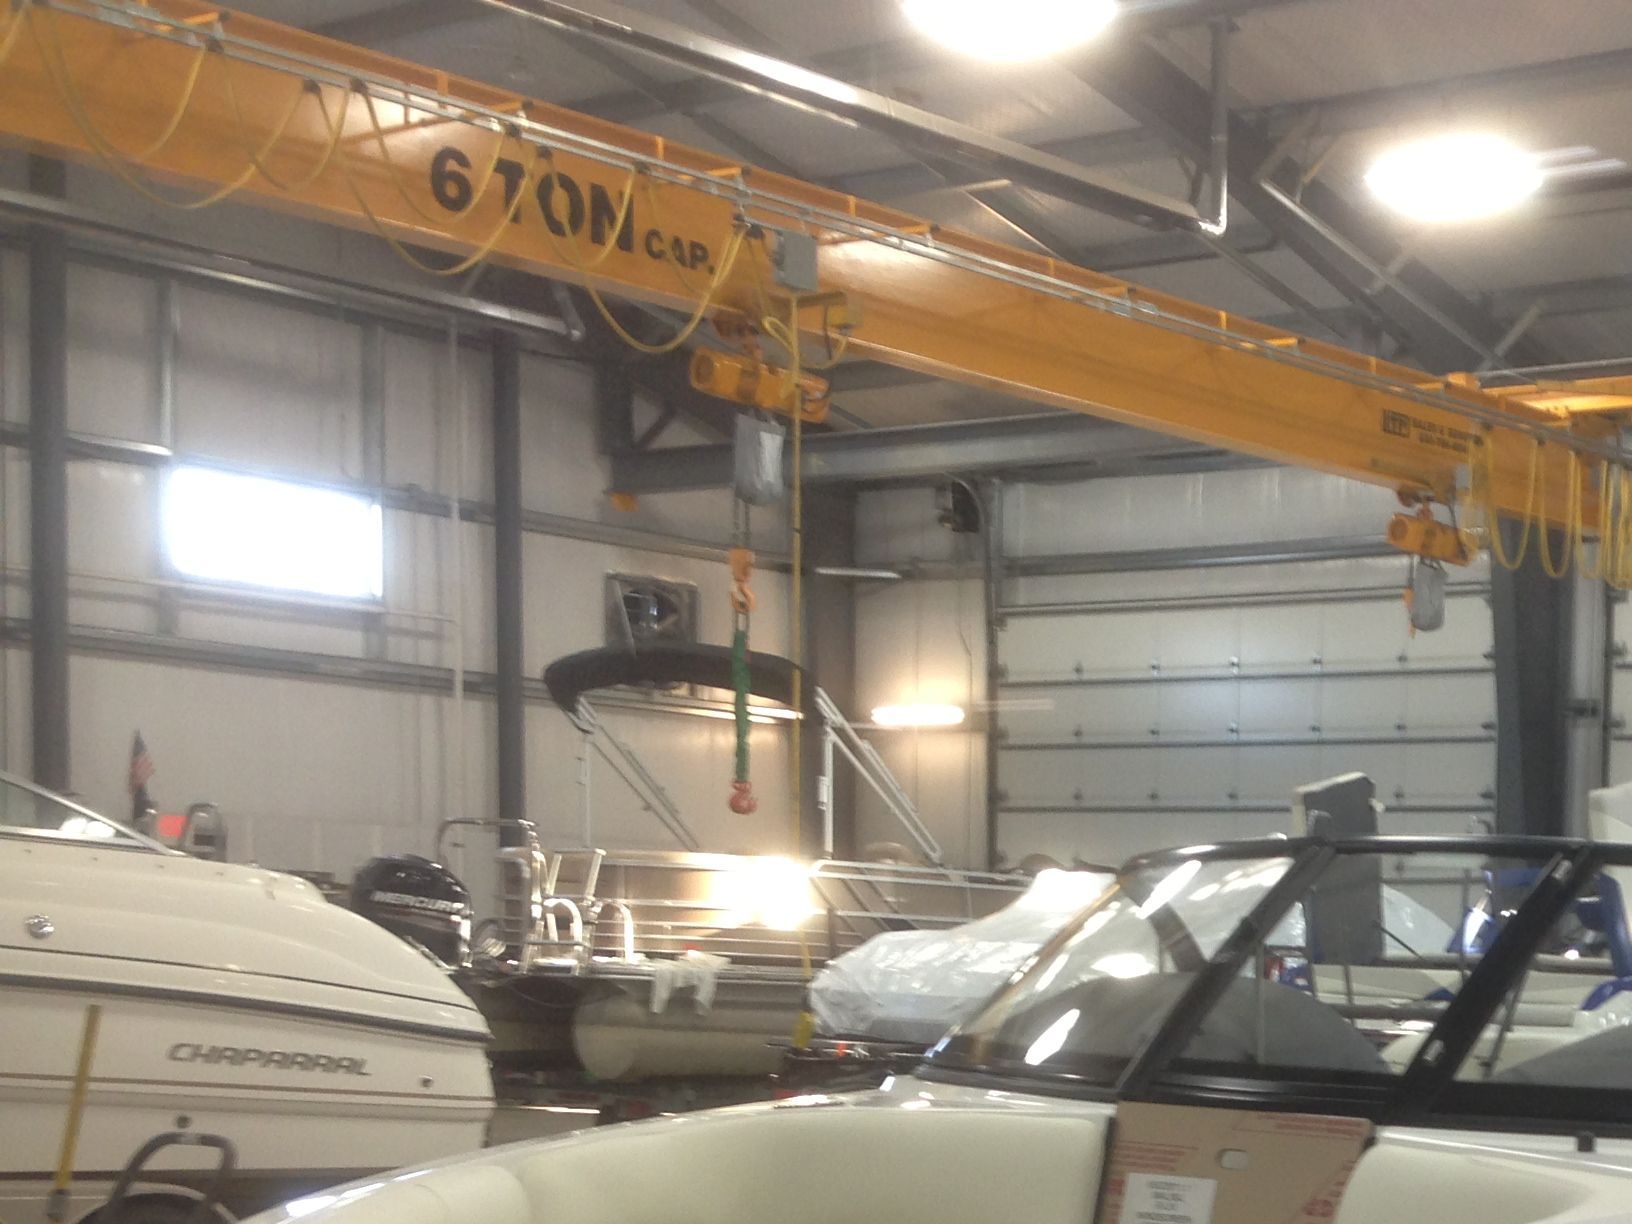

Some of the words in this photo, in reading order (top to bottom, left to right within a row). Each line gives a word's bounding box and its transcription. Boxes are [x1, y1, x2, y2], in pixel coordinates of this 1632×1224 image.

[430, 146, 473, 213] 6
[493, 156, 635, 253] TON
[644, 228, 716, 276] CAP.
[166, 1042, 373, 1077] CHAPARRAL
